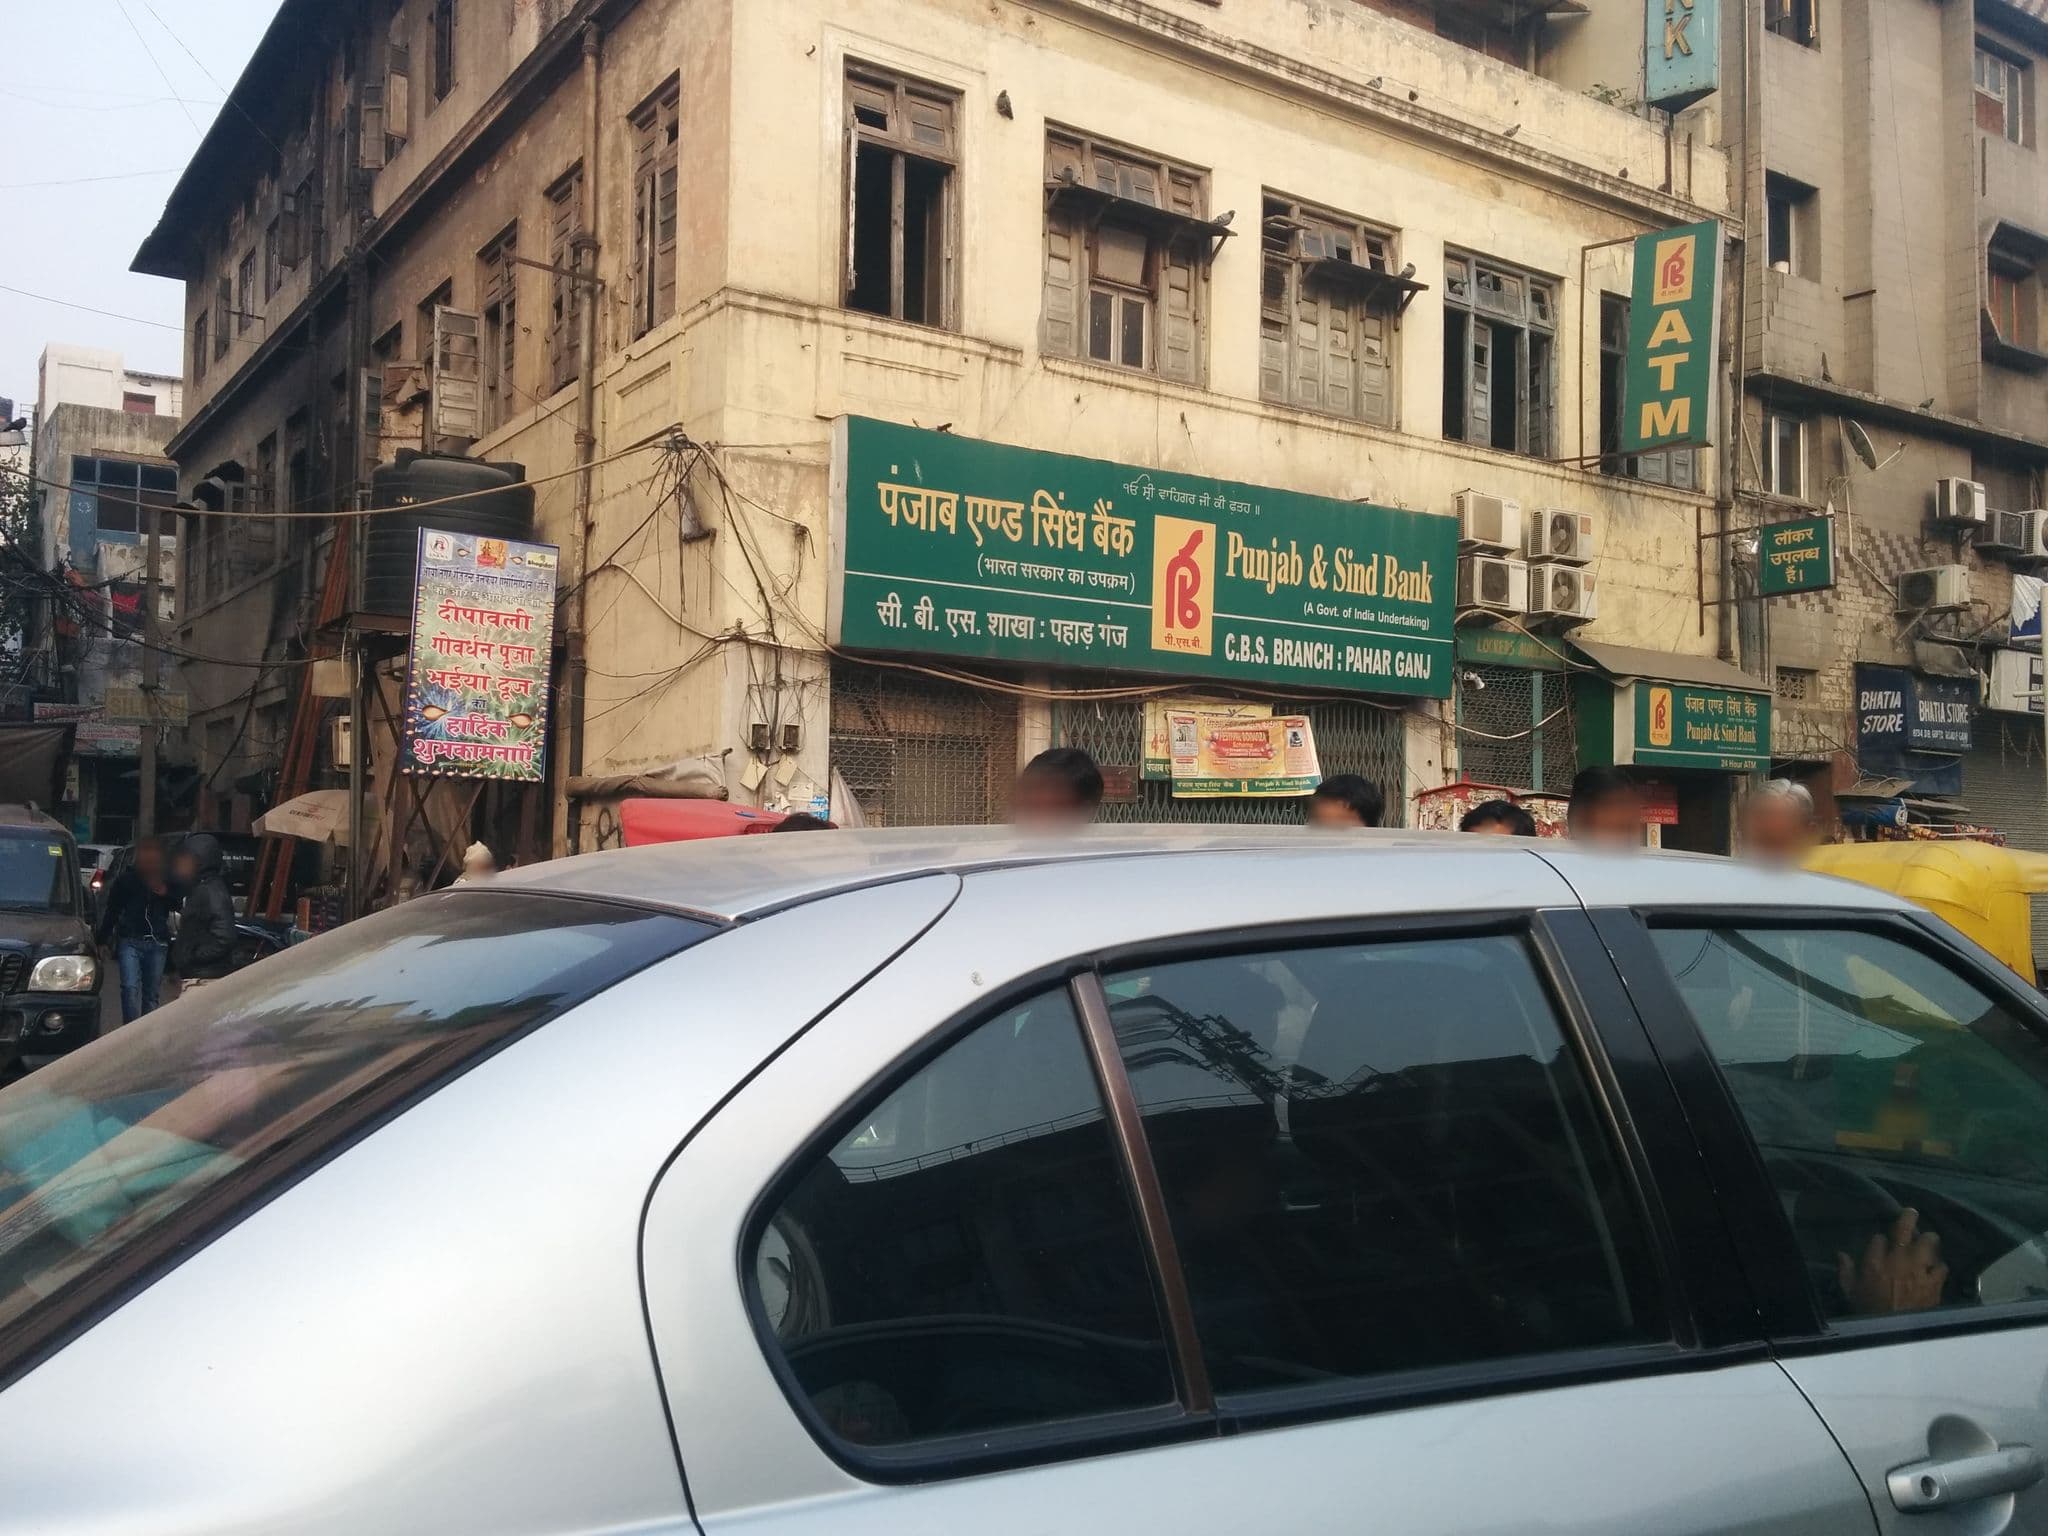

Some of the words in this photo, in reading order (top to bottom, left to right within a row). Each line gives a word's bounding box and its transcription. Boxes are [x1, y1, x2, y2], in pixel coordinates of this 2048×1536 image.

[1641, 309, 1692, 439] ATM
[878, 465, 959, 534] पंजाब
[965, 496, 1024, 547] एण्ड
[1031, 489, 1086, 551] सिंध
[1092, 498, 1136, 557] बैंक
[977, 553, 1017, 577] (भारत
[1021, 562, 1065, 583] सरकार
[1067, 567, 1084, 584] का
[1226, 531, 1303, 594] Punjab
[1309, 544, 1327, 590] &
[1333, 547, 1378, 598] Sind
[1383, 554, 1433, 604] Bank
[438, 598, 534, 631] दीपावली
[877, 592, 908, 628] सी.
[913, 596, 939, 631] बी.
[945, 608, 981, 637] एस.
[987, 611, 1035, 640] शाखा
[1050, 618, 1094, 650] पहाड़
[1098, 614, 1127, 648] गंज
[1304, 602, 1314, 616] (A
[1316, 605, 1340, 619] Govt.
[1343, 607, 1352, 619] of
[1354, 608, 1375, 622] India
[1378, 611, 1430, 631] Undertaking)
[431, 630, 495, 661] गोवर्धन
[499, 642, 535, 669] पूजा
[1225, 632, 1269, 665] C.B.S.
[1274, 638, 1333, 670] BRANCH
[1346, 645, 1391, 676] PAHAR
[1395, 651, 1431, 680] GANJ
[427, 665, 491, 694] भईया
[497, 676, 533, 702] दूज
[1861, 691, 1901, 711] BHATIA
[1919, 700, 1945, 723] BHATIA
[1947, 703, 1969, 724] STORE
[446, 711, 511, 739] हार्दिक
[1686, 722, 1711, 744] Punjab
[1713, 723, 1720, 741] &
[1722, 724, 1737, 743] Sind
[1740, 726, 1756, 743] Bank
[1862, 714, 1904, 734] STORE
[1729, 760, 1742, 768] Hour
[1743, 760, 1757, 769] ATM
